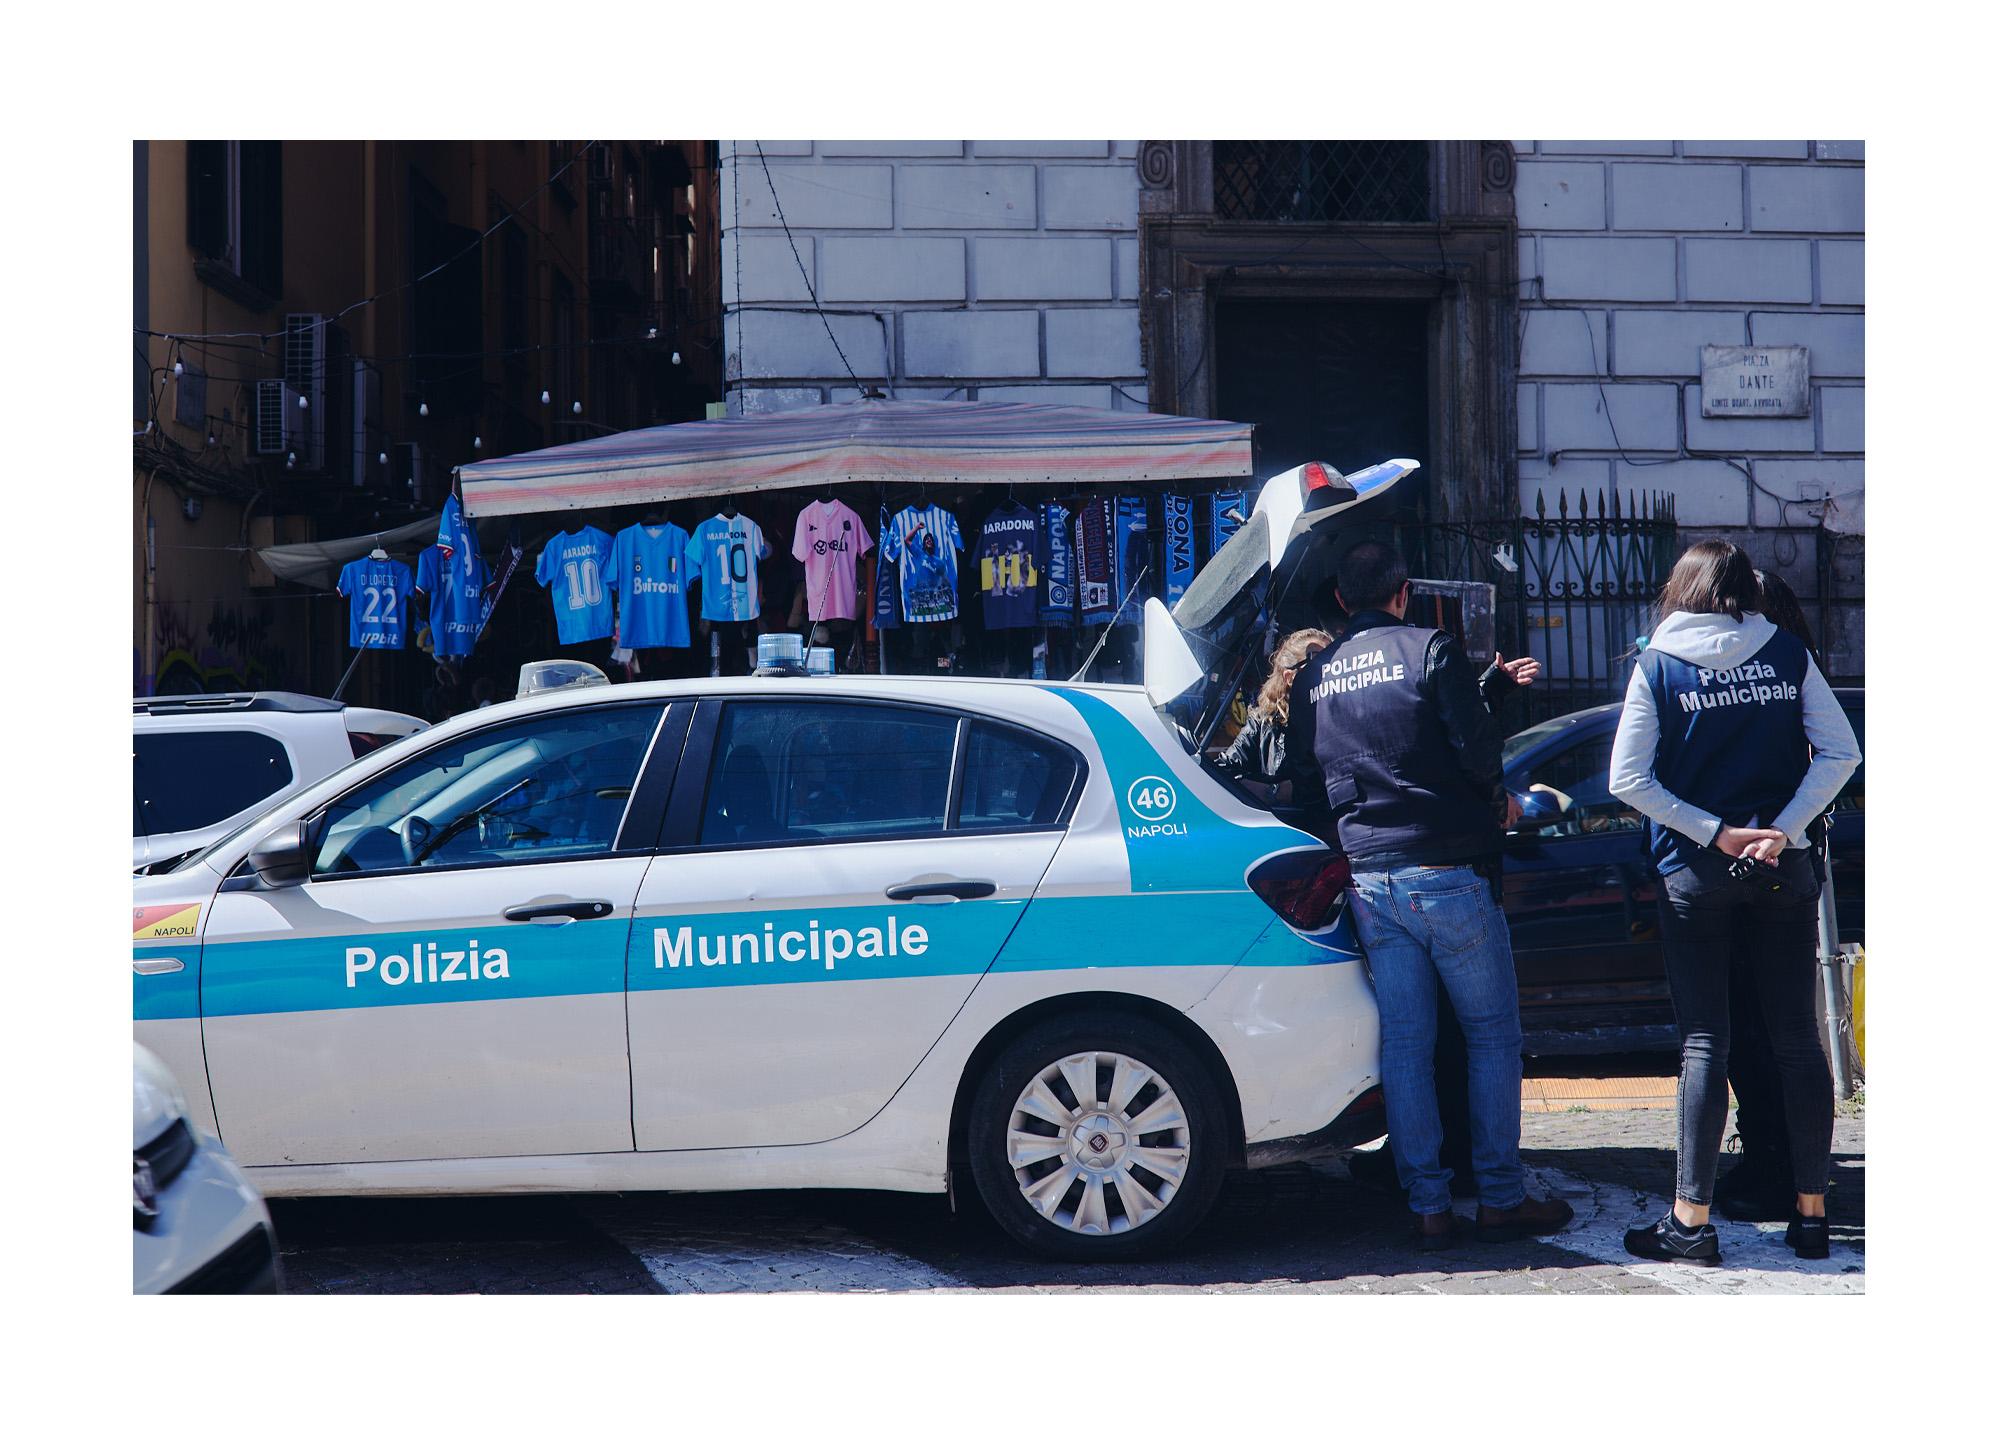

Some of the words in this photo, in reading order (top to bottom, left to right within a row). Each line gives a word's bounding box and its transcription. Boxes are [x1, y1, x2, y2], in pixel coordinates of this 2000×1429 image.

[1739, 375, 1775, 390] DANTE
[716, 543, 748, 584] 10
[563, 558, 603, 610] 10
[362, 587, 398, 625] 22
[1321, 649, 1385, 679] POLIZIA
[1698, 660, 1777, 687] Polizia
[1309, 663, 1405, 704] MUNICIPALE
[1678, 680, 1798, 713] Municipale
[1136, 786, 1170, 809] 46
[1127, 823, 1188, 839] NAPOLI
[154, 926, 195, 937] NAPOLI
[345, 939, 510, 988] Polizia
[653, 915, 928, 970] Municipale
